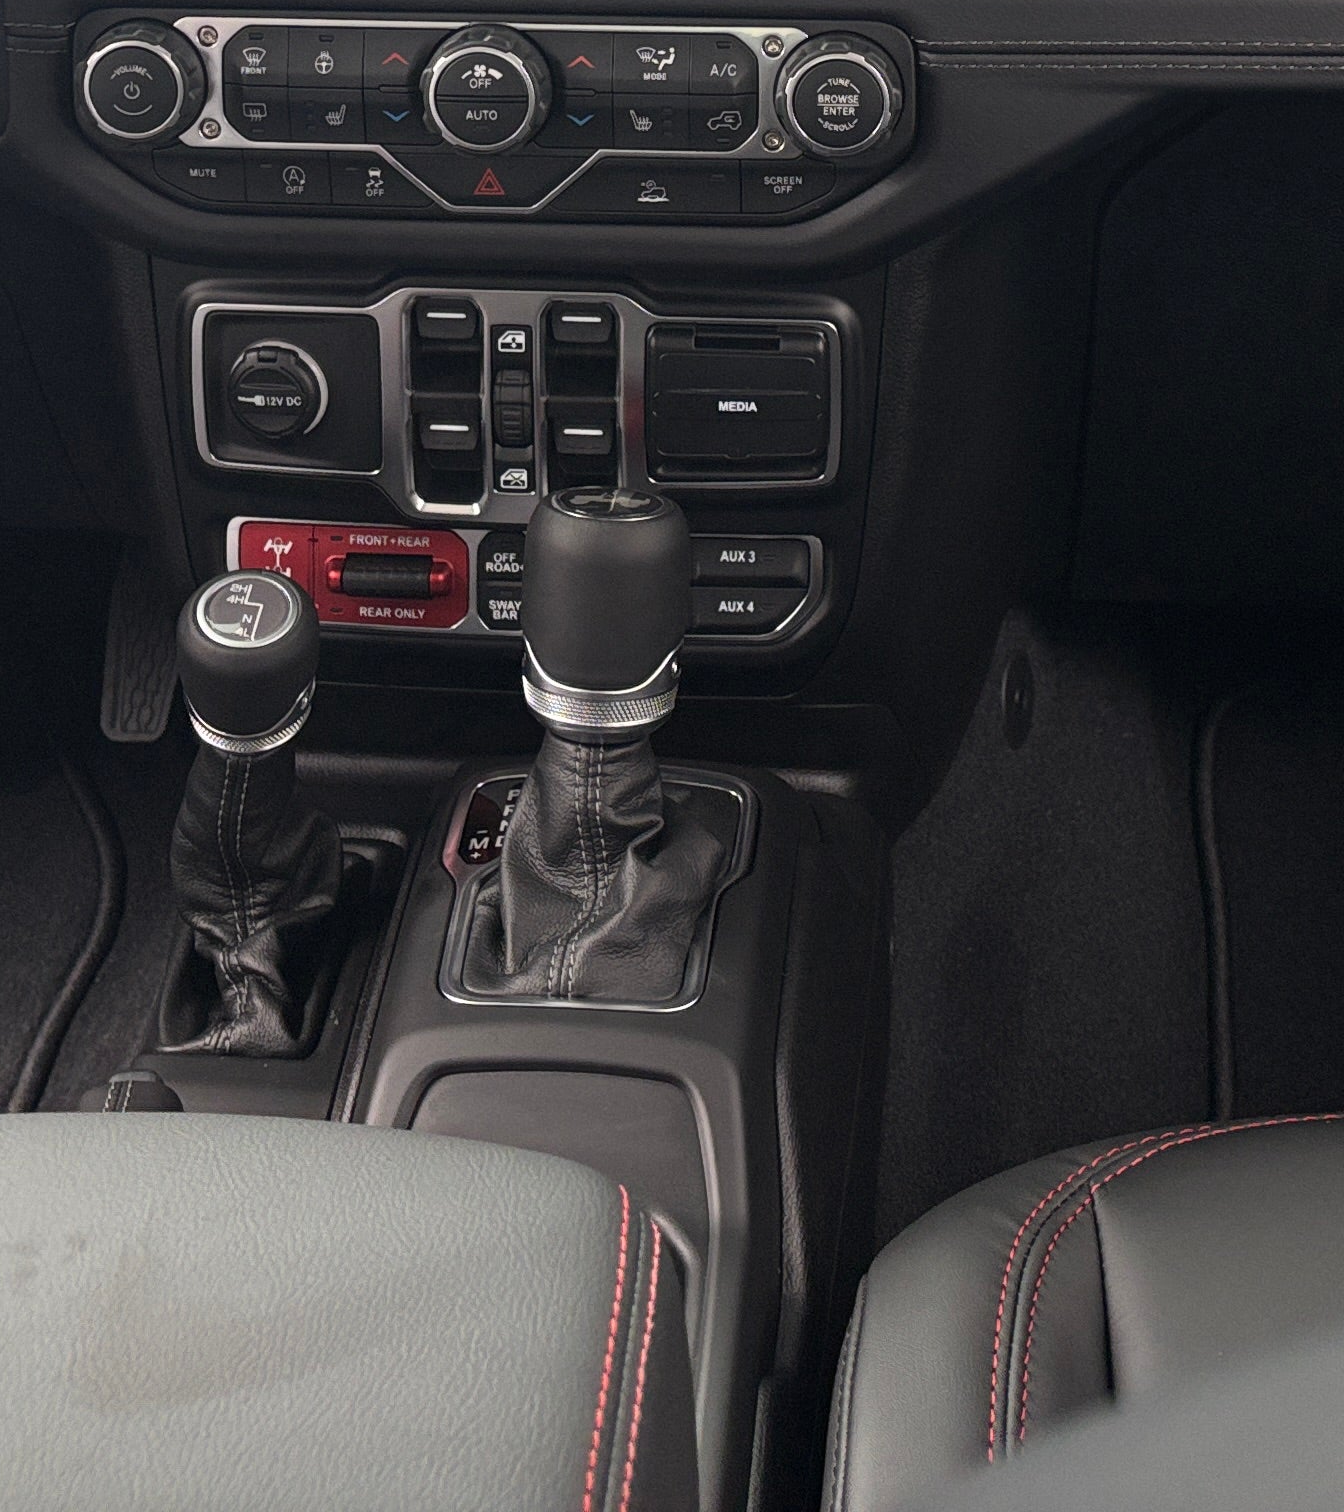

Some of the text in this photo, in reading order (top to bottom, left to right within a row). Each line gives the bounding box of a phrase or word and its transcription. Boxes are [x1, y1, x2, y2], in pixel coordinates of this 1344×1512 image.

[114, 65, 148, 76] VOLUME
[241, 66, 267, 75] FRONT
[709, 63, 737, 77] A/C
[469, 78, 492, 89] OFF
[827, 78, 851, 87] TUNE
[817, 94, 859, 104] BROWSE
[466, 109, 498, 121] AUTO
[823, 107, 856, 116] ENTER
[822, 120, 855, 132] SCROLL
[189, 168, 217, 178] MUTE
[764, 176, 803, 185] SCREEN
[285, 185, 305, 195] OFF
[365, 187, 385, 197] OFF
[773, 186, 793, 194] OFF
[266, 396, 302, 406] 12V DC
[718, 401, 758, 412] MEDIA
[493, 552, 517, 563] OFF
[719, 551, 756, 563] AUX 3
[225, 595, 245, 604] 4H
[488, 599, 522, 611] SWAY
[718, 601, 754, 613] AUX 4
[241, 613, 253, 624] N
[359, 606, 426, 620] REAR ONLY
[492, 610, 518, 620] BAR
[468, 836, 490, 851] M
